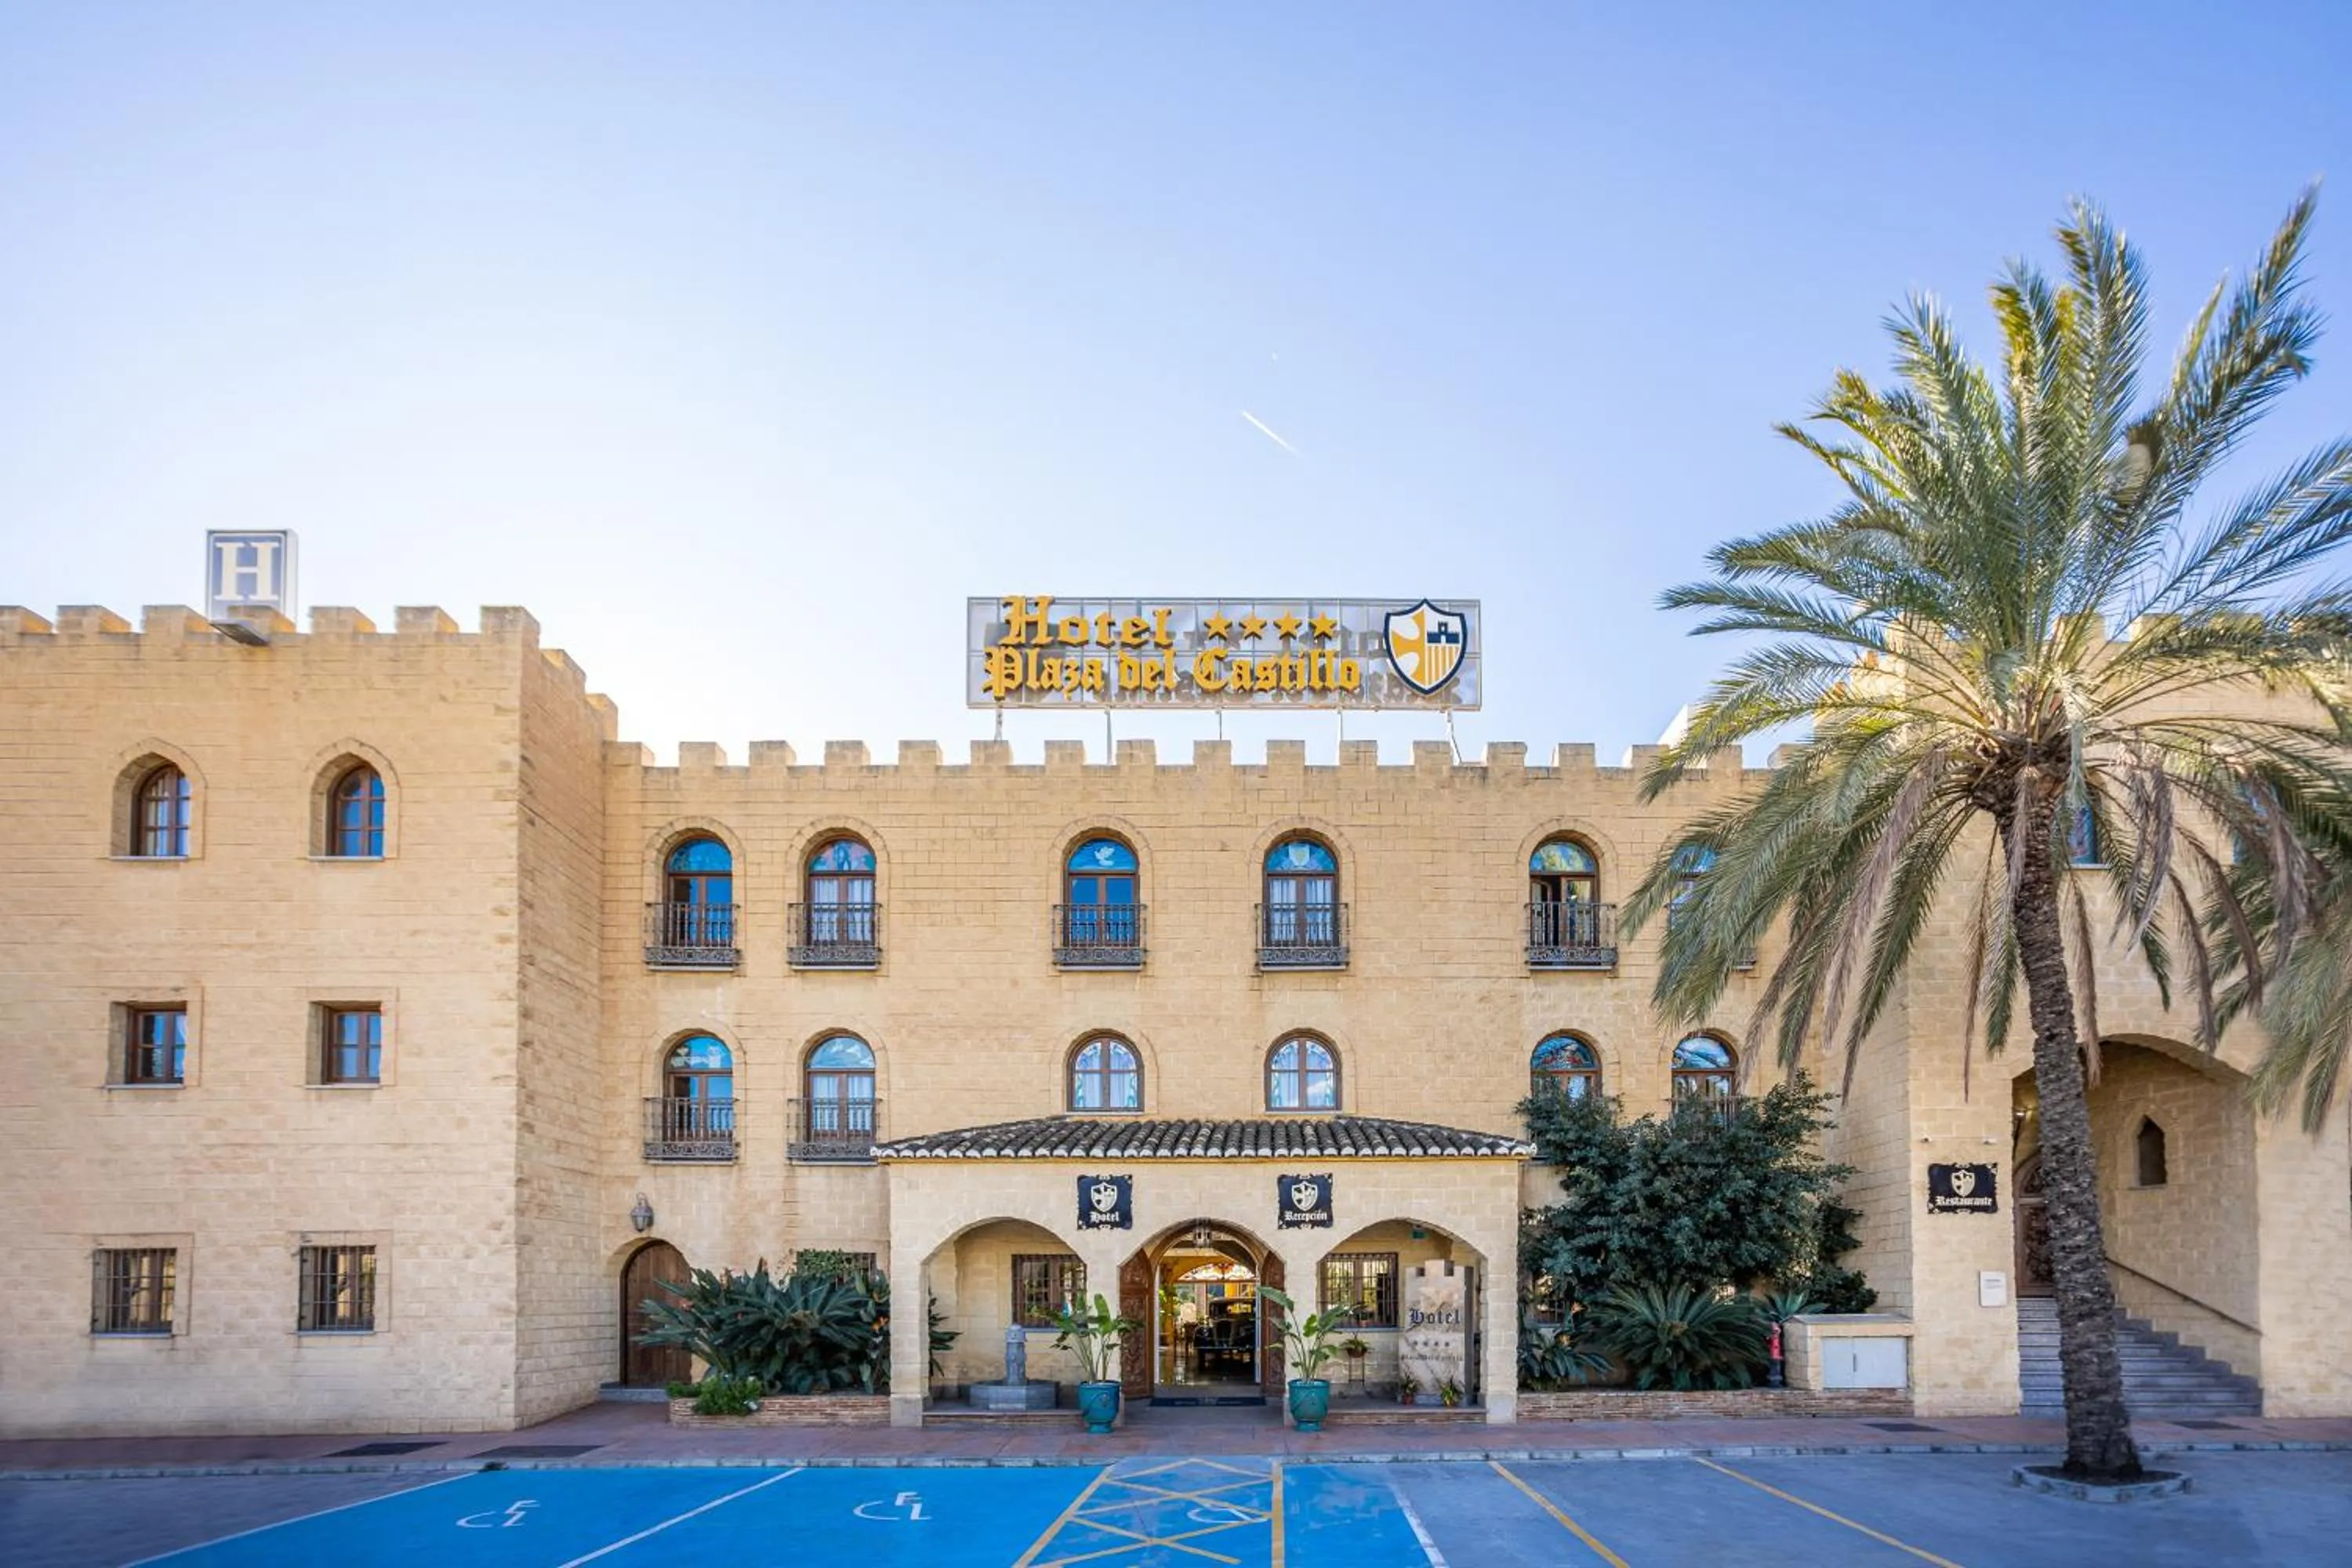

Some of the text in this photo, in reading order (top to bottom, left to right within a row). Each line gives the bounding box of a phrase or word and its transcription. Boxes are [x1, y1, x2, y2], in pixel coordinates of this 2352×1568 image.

[213, 541, 279, 601] H
[999, 595, 1172, 648] Hotel
[982, 646, 1361, 701] Plaza del Castillo
[1090, 1211, 1120, 1223] Hotel
[1935, 1196, 1992, 1206] Restaurante
[1410, 1307, 1461, 1325] Hotel
